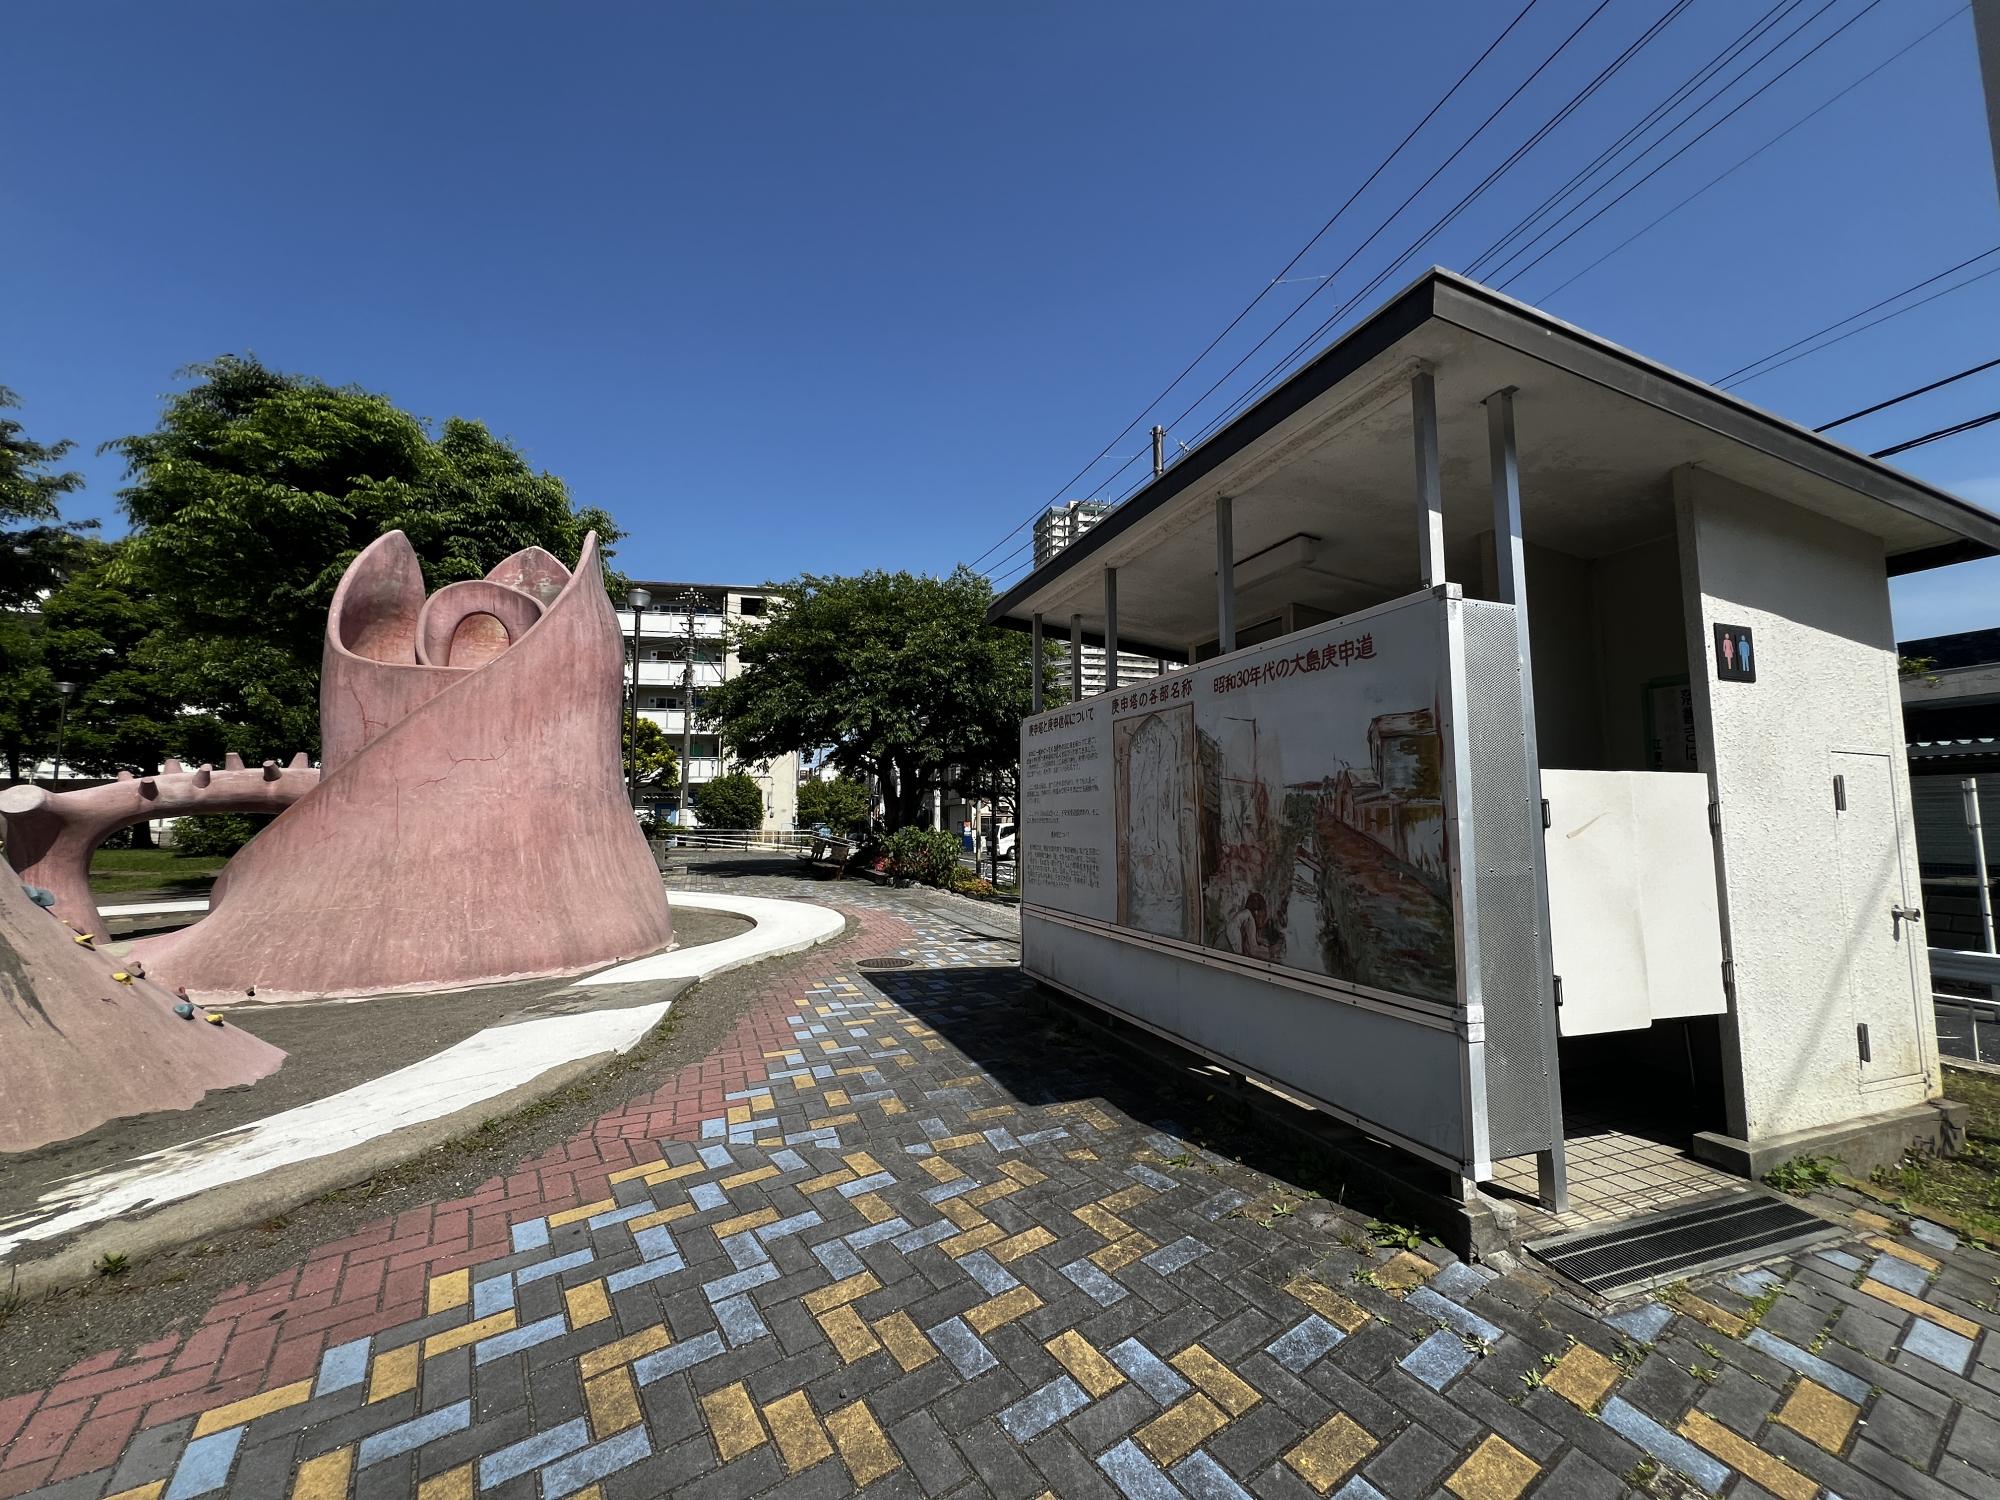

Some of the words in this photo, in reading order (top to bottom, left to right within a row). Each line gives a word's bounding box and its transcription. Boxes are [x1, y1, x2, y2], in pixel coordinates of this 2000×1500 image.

[1213, 632, 1377, 694] 昭和30年代の大島庚申道
[1111, 678, 1193, 715] 庚申塔の各部名称
